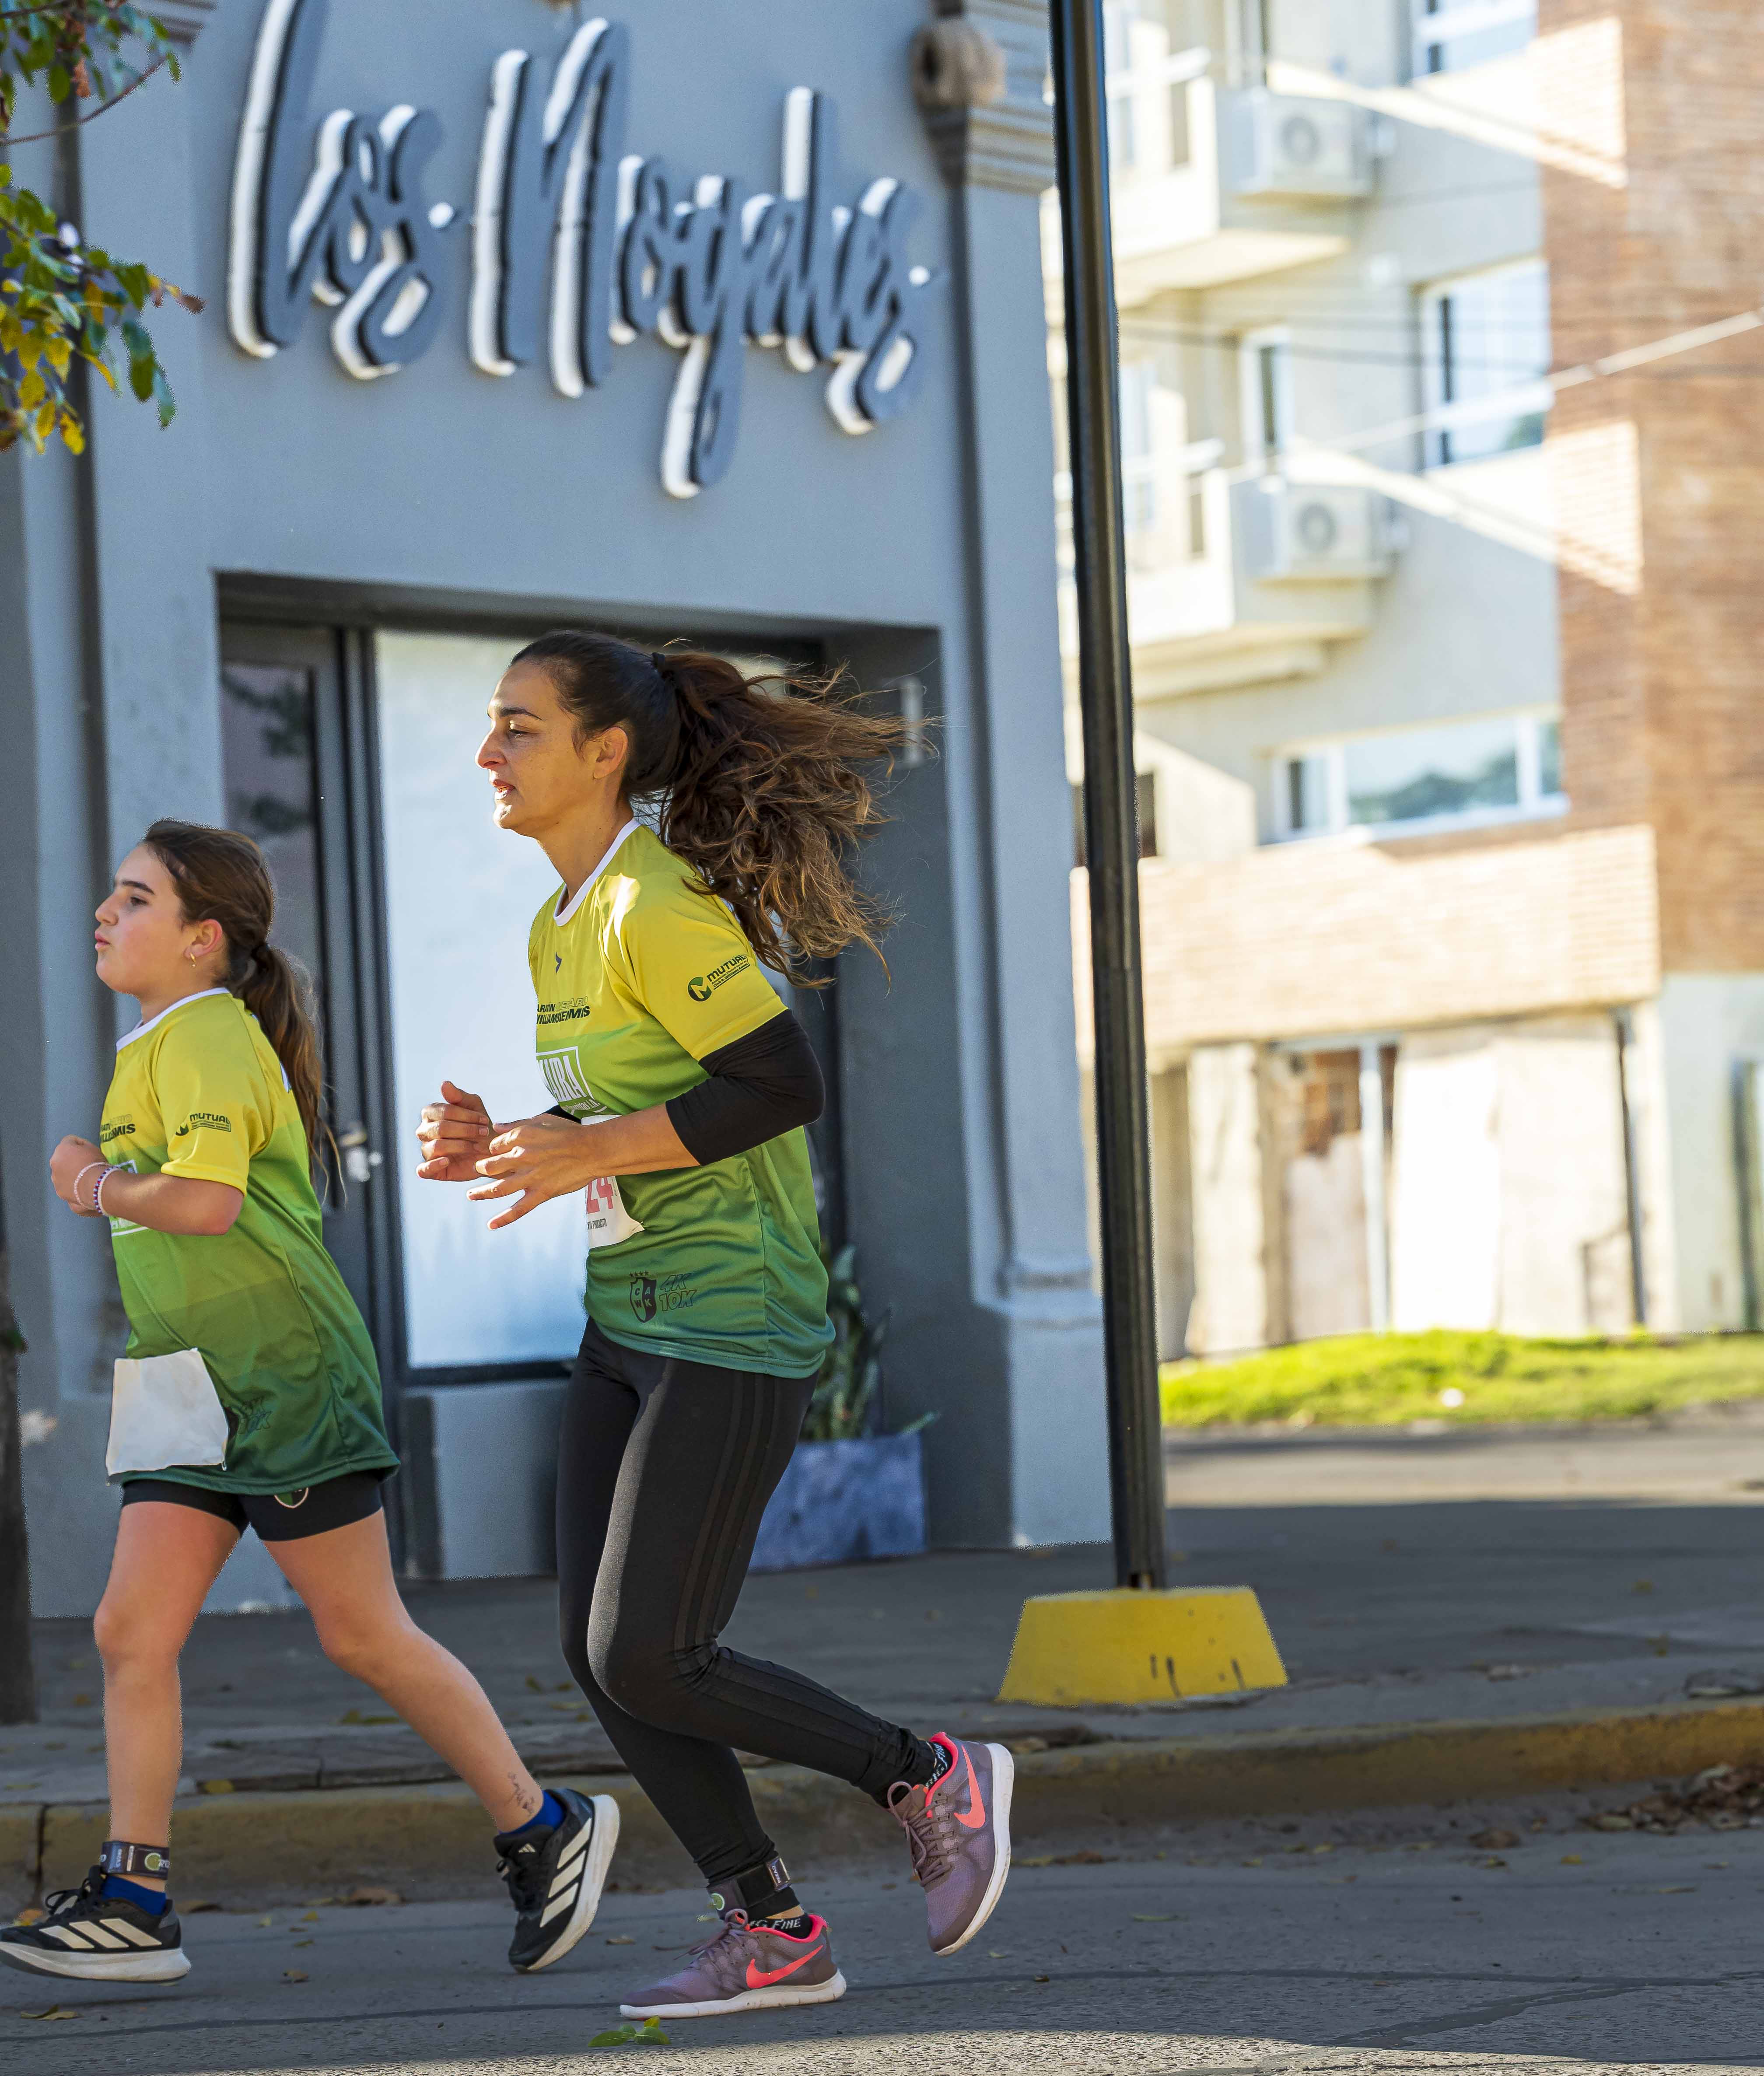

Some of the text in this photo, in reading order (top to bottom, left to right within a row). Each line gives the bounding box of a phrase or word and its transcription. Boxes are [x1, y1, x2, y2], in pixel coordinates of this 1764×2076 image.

[660, 1273, 691, 1292] 4K
[659, 1290, 696, 1311] 10K
[772, 1918, 801, 1929] FINE
